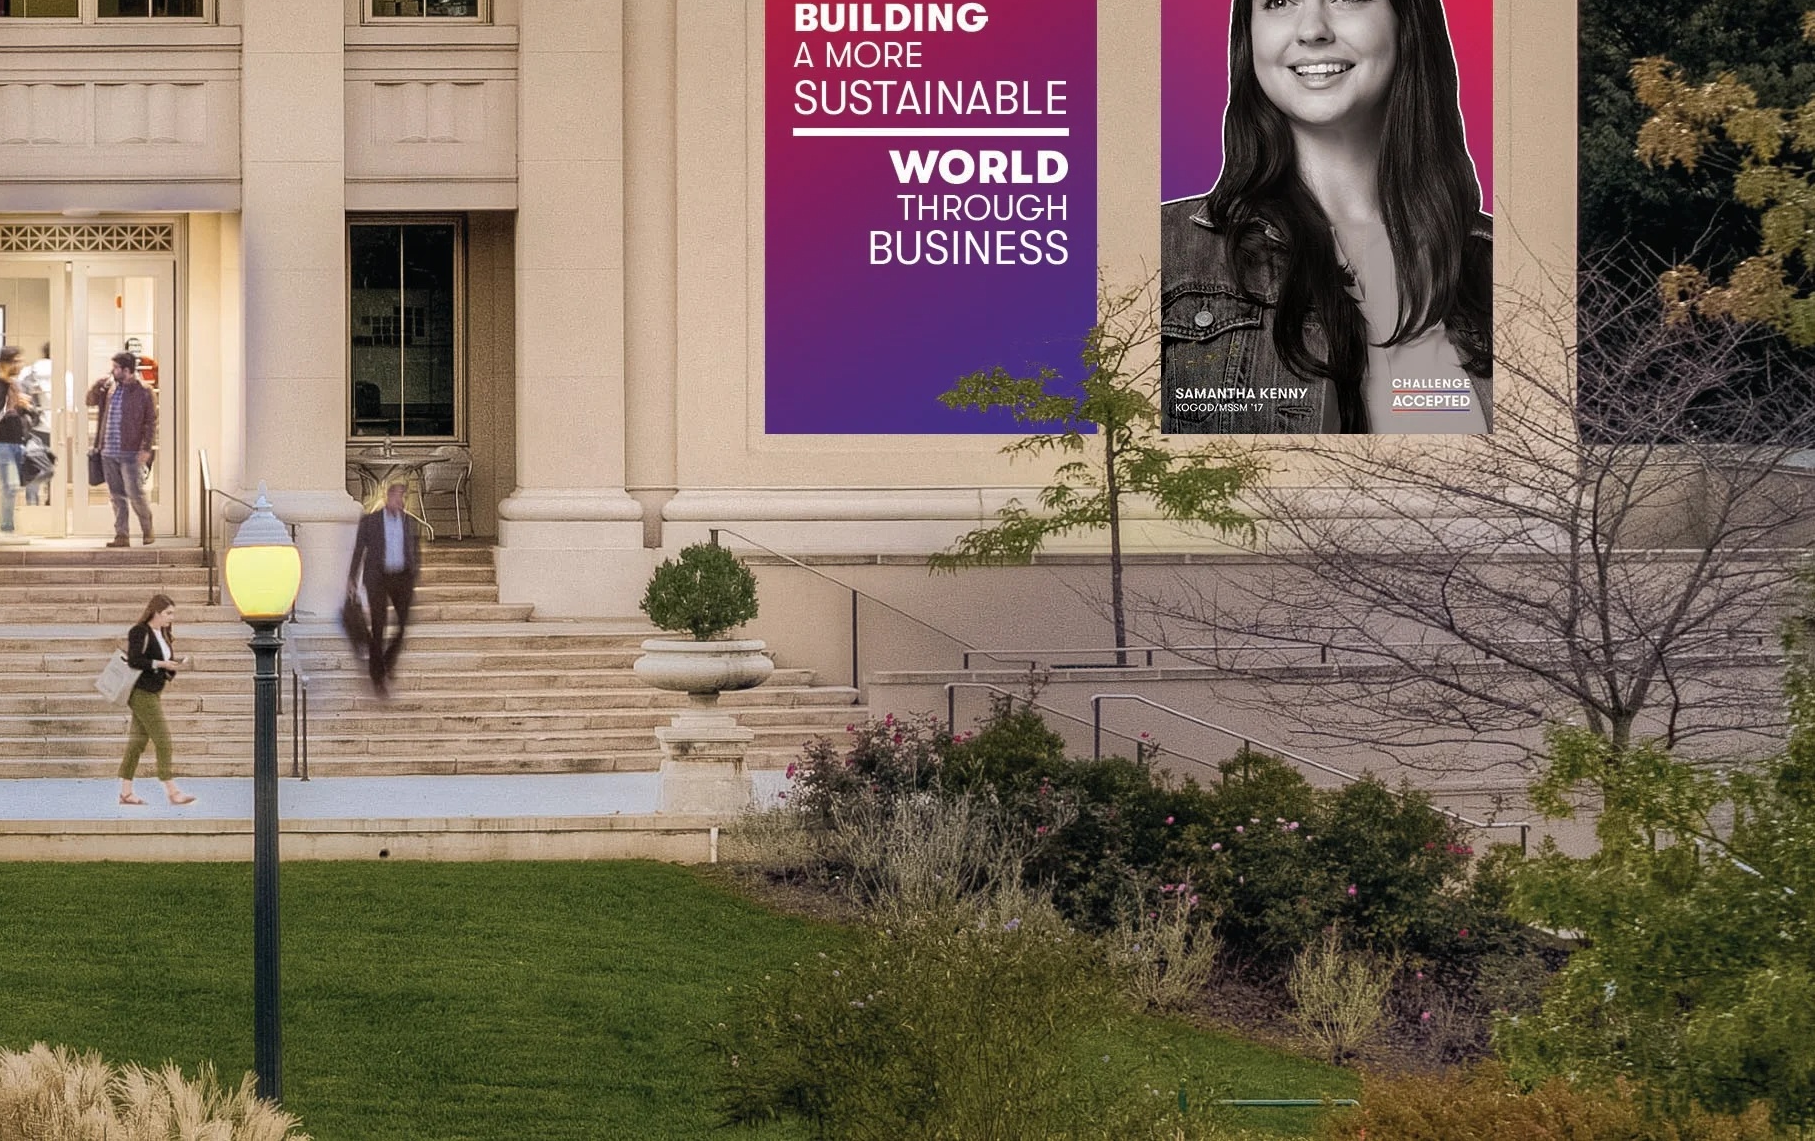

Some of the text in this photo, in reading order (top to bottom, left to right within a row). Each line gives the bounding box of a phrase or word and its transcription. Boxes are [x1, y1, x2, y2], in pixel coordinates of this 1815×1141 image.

[794, 2, 989, 33] BUILDING
[793, 40, 922, 69] A MORE
[794, 79, 1067, 116] SUSTAINABLE
[888, 149, 1069, 185] WORLD
[896, 193, 1067, 222] THROUGH
[870, 229, 1069, 266] BUSINESS
[1175, 388, 1308, 399] SAMANTHA KENNY
[1392, 378, 1471, 389] CHALLENGE
[1175, 403, 1264, 412] KOGOD/MSSM '17
[1392, 395, 1471, 407] ACCEPTED
